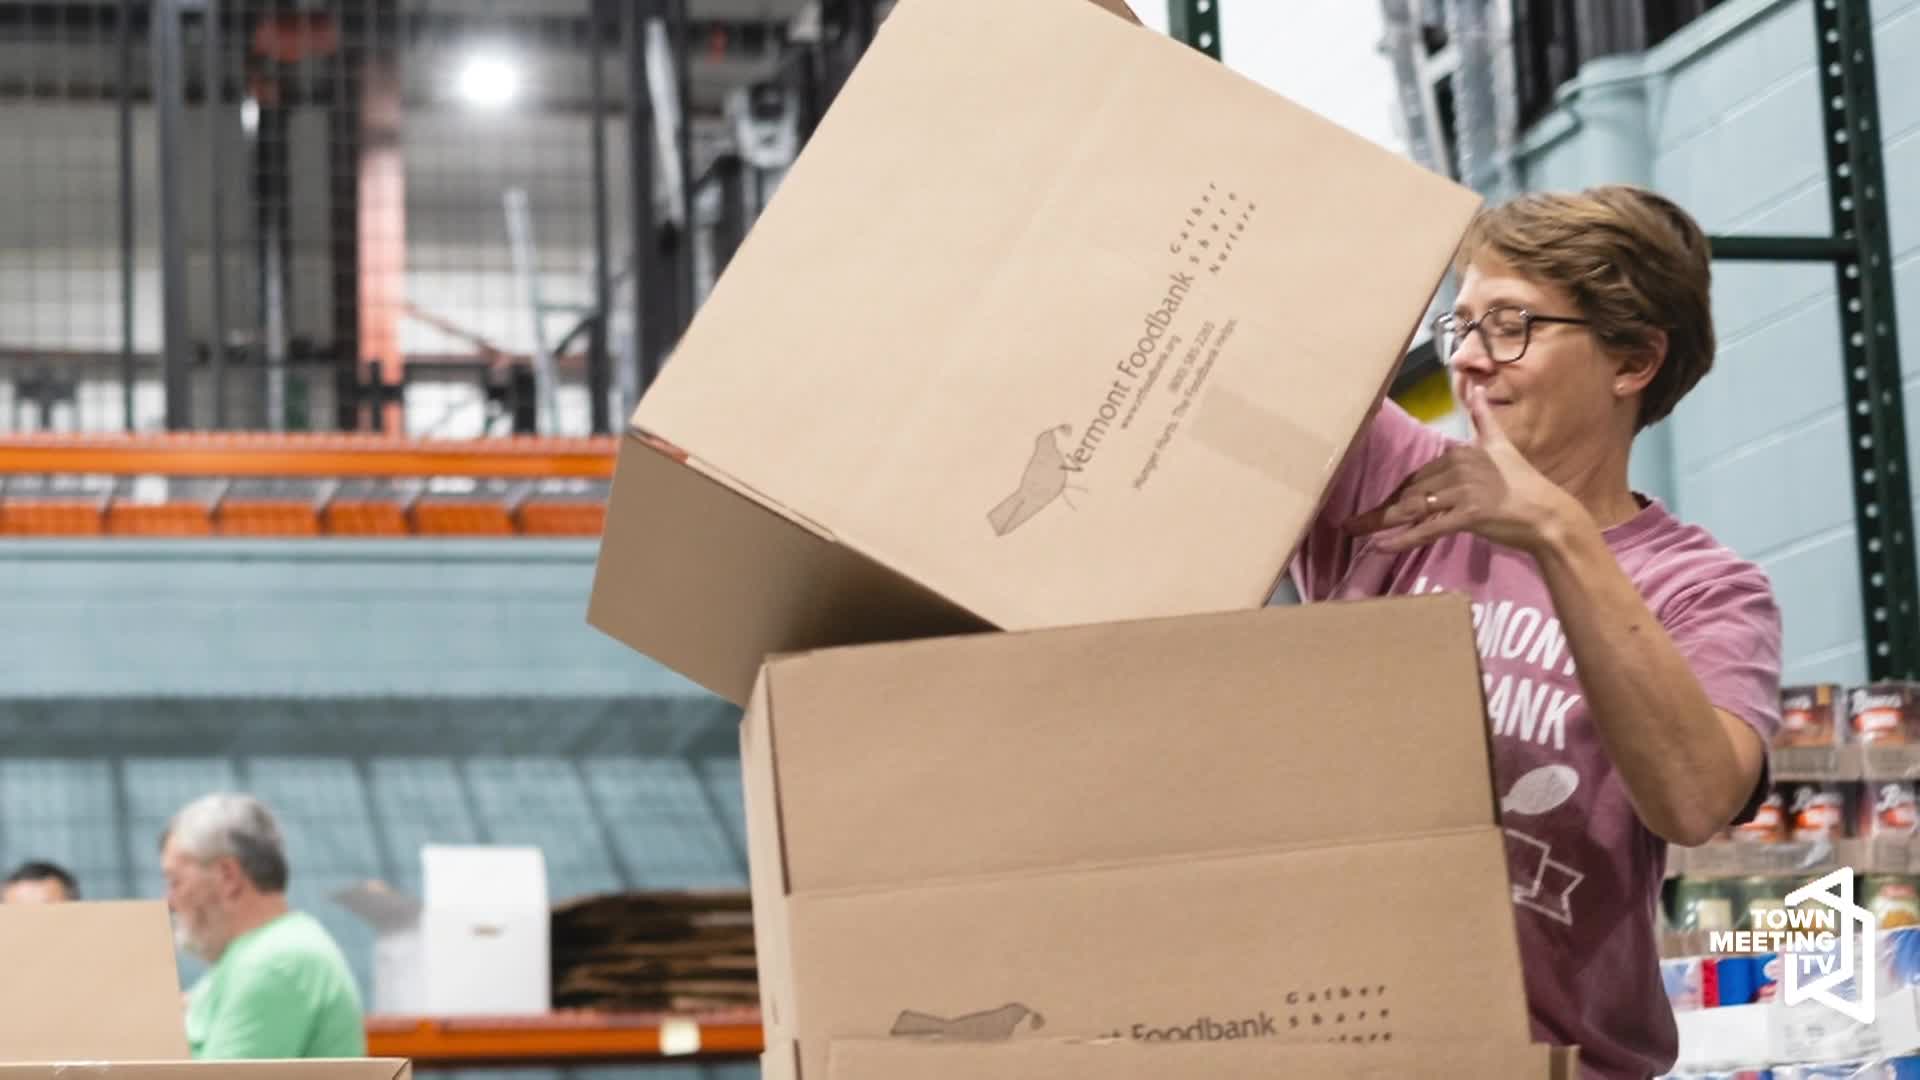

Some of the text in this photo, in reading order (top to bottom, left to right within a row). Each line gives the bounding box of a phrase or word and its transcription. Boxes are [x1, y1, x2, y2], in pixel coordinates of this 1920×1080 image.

[1168, 181, 1216, 254] Gather
[1059, 271, 1195, 472] Vermont Foodbank
[1286, 984, 1385, 1004] Gather
[1131, 1010, 1276, 1041] Foodbank
